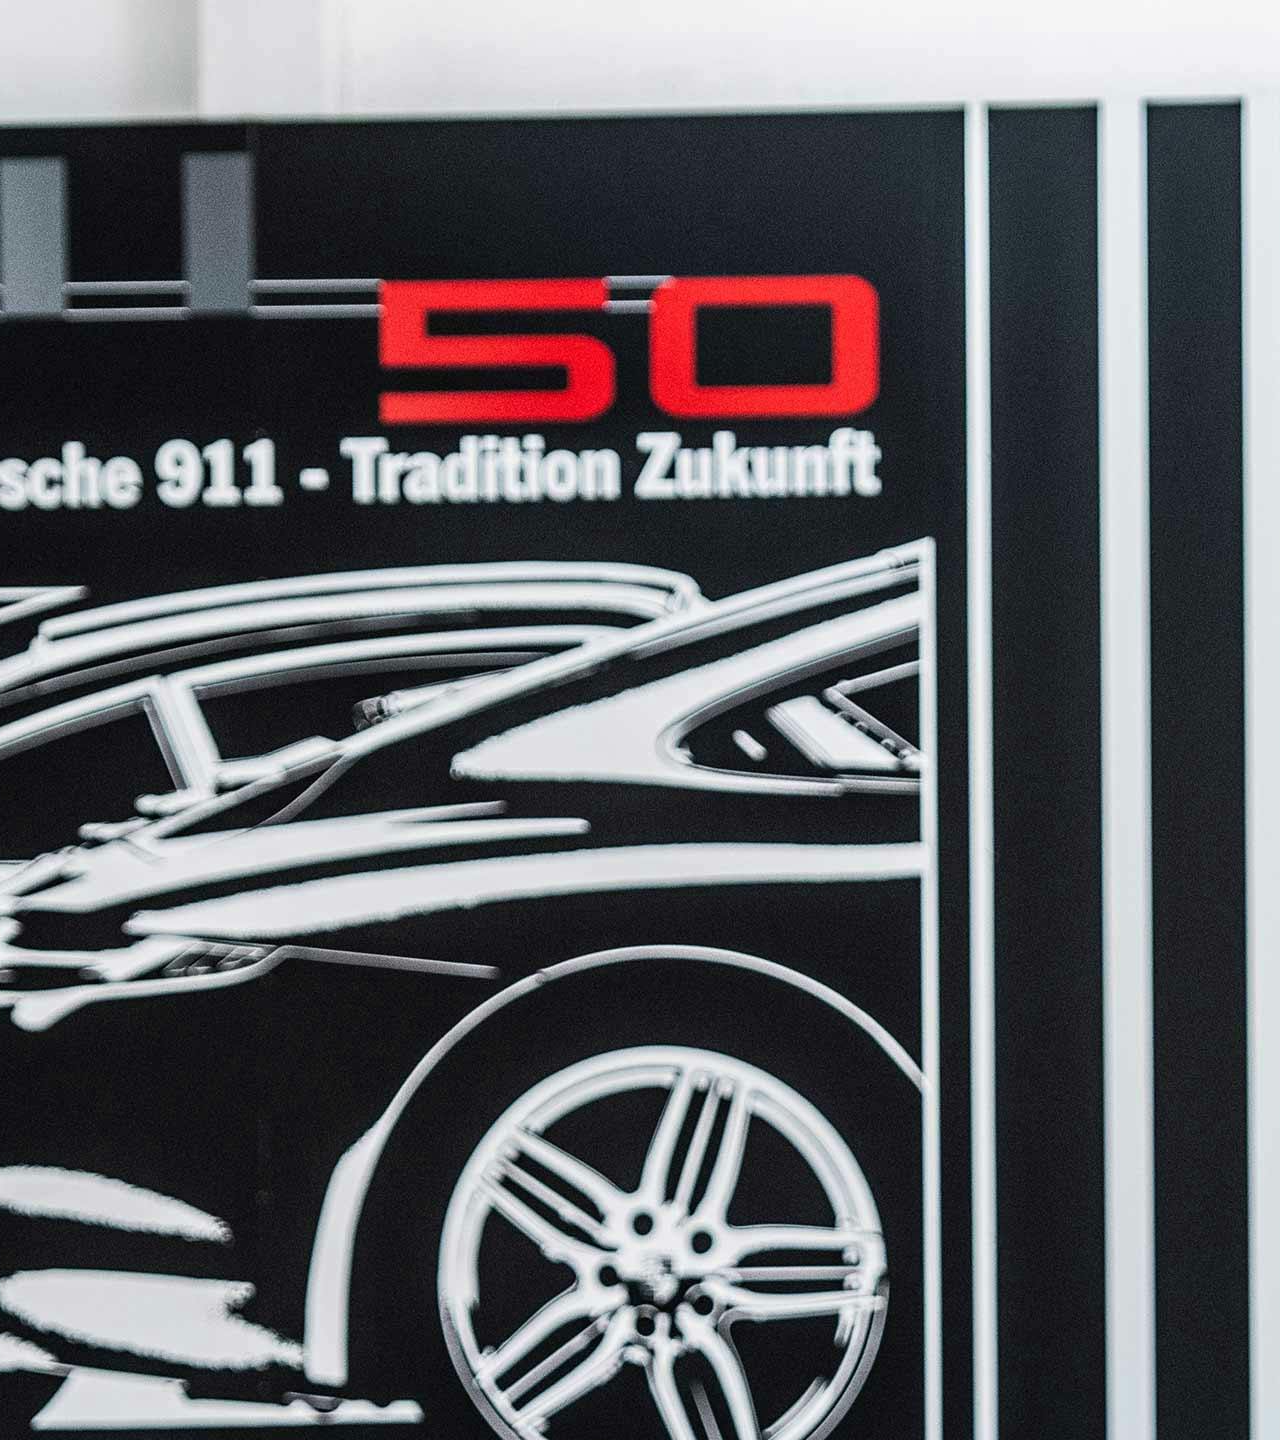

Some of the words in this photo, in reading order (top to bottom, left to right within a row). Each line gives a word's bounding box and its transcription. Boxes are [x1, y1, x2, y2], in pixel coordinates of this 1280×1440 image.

[378, 274, 880, 423] 50
[154, 438, 283, 507] 911
[339, 433, 621, 504] Tradition
[634, 427, 882, 499] Zukunft
